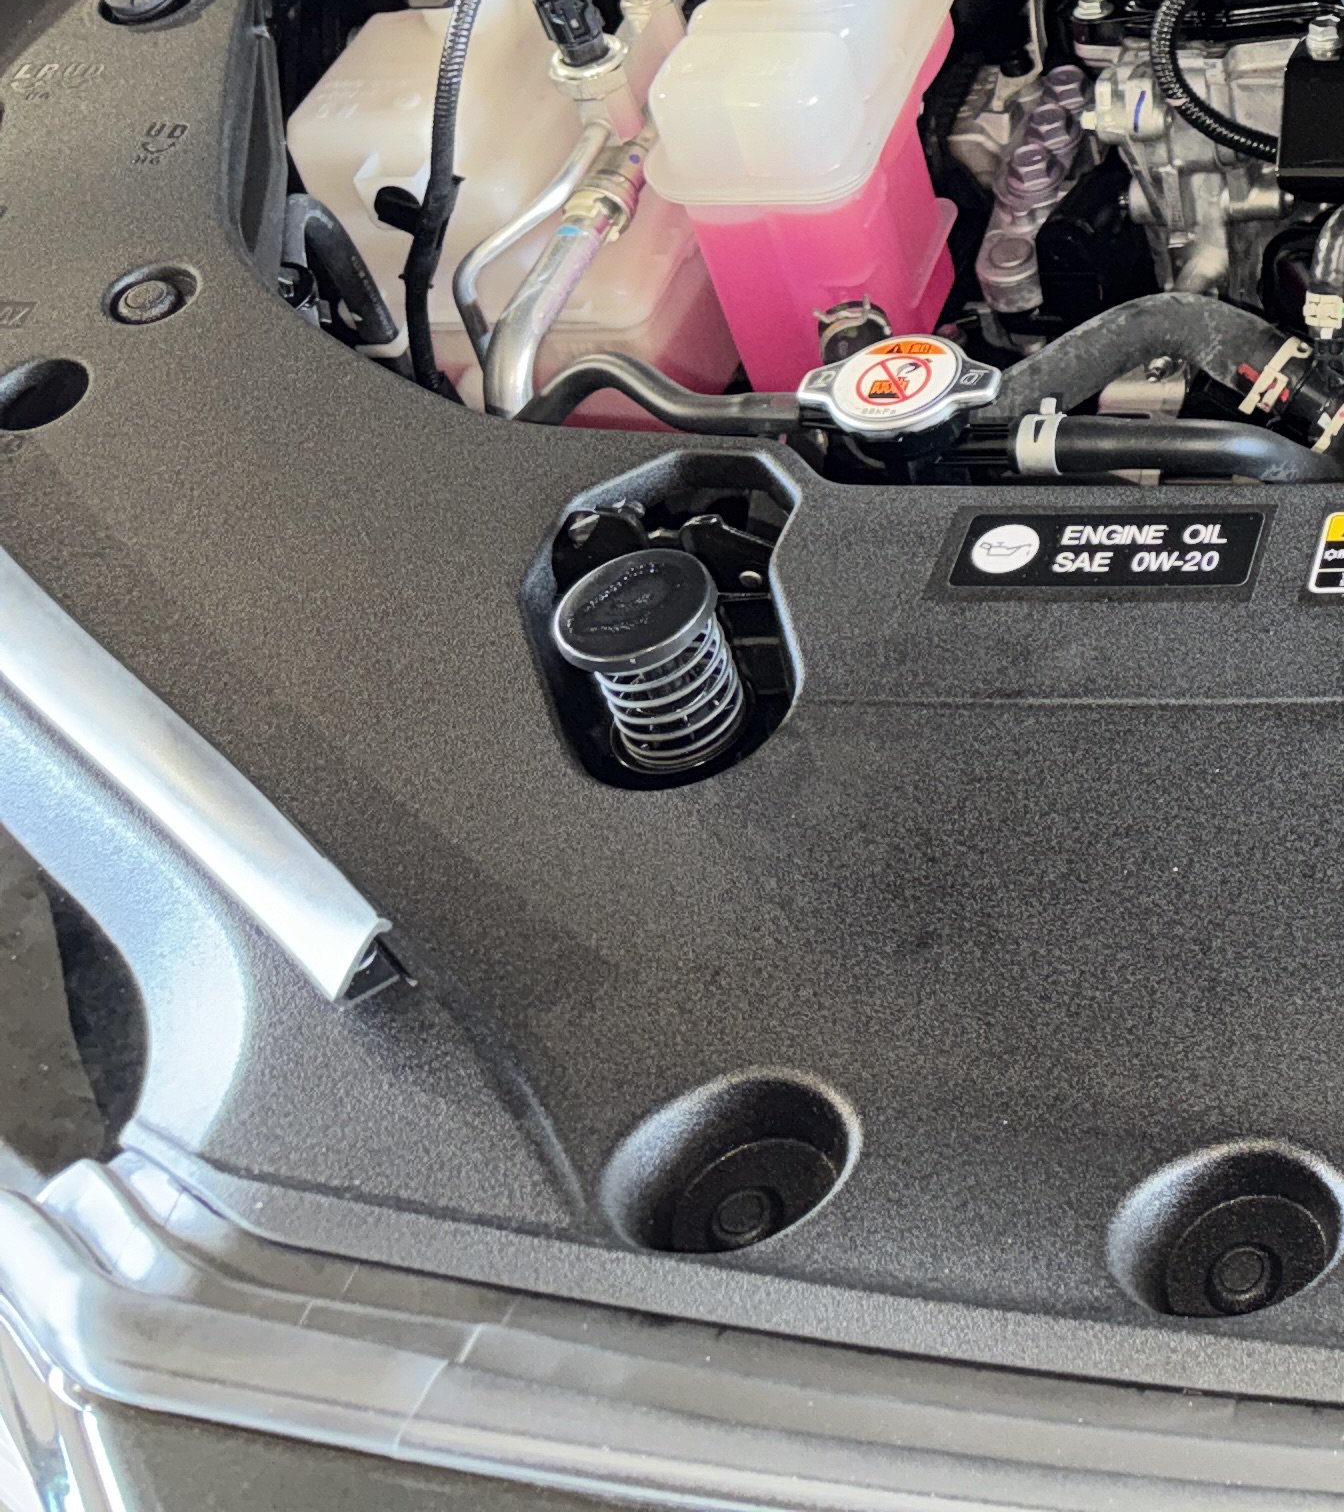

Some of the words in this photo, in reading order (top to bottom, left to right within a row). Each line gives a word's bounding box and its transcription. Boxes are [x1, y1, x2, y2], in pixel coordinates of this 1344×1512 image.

[1060, 524, 1169, 545] ENGINE
[1181, 524, 1228, 544] OIL
[1051, 552, 1114, 573] SAE
[1130, 551, 1220, 572] 0W-20
